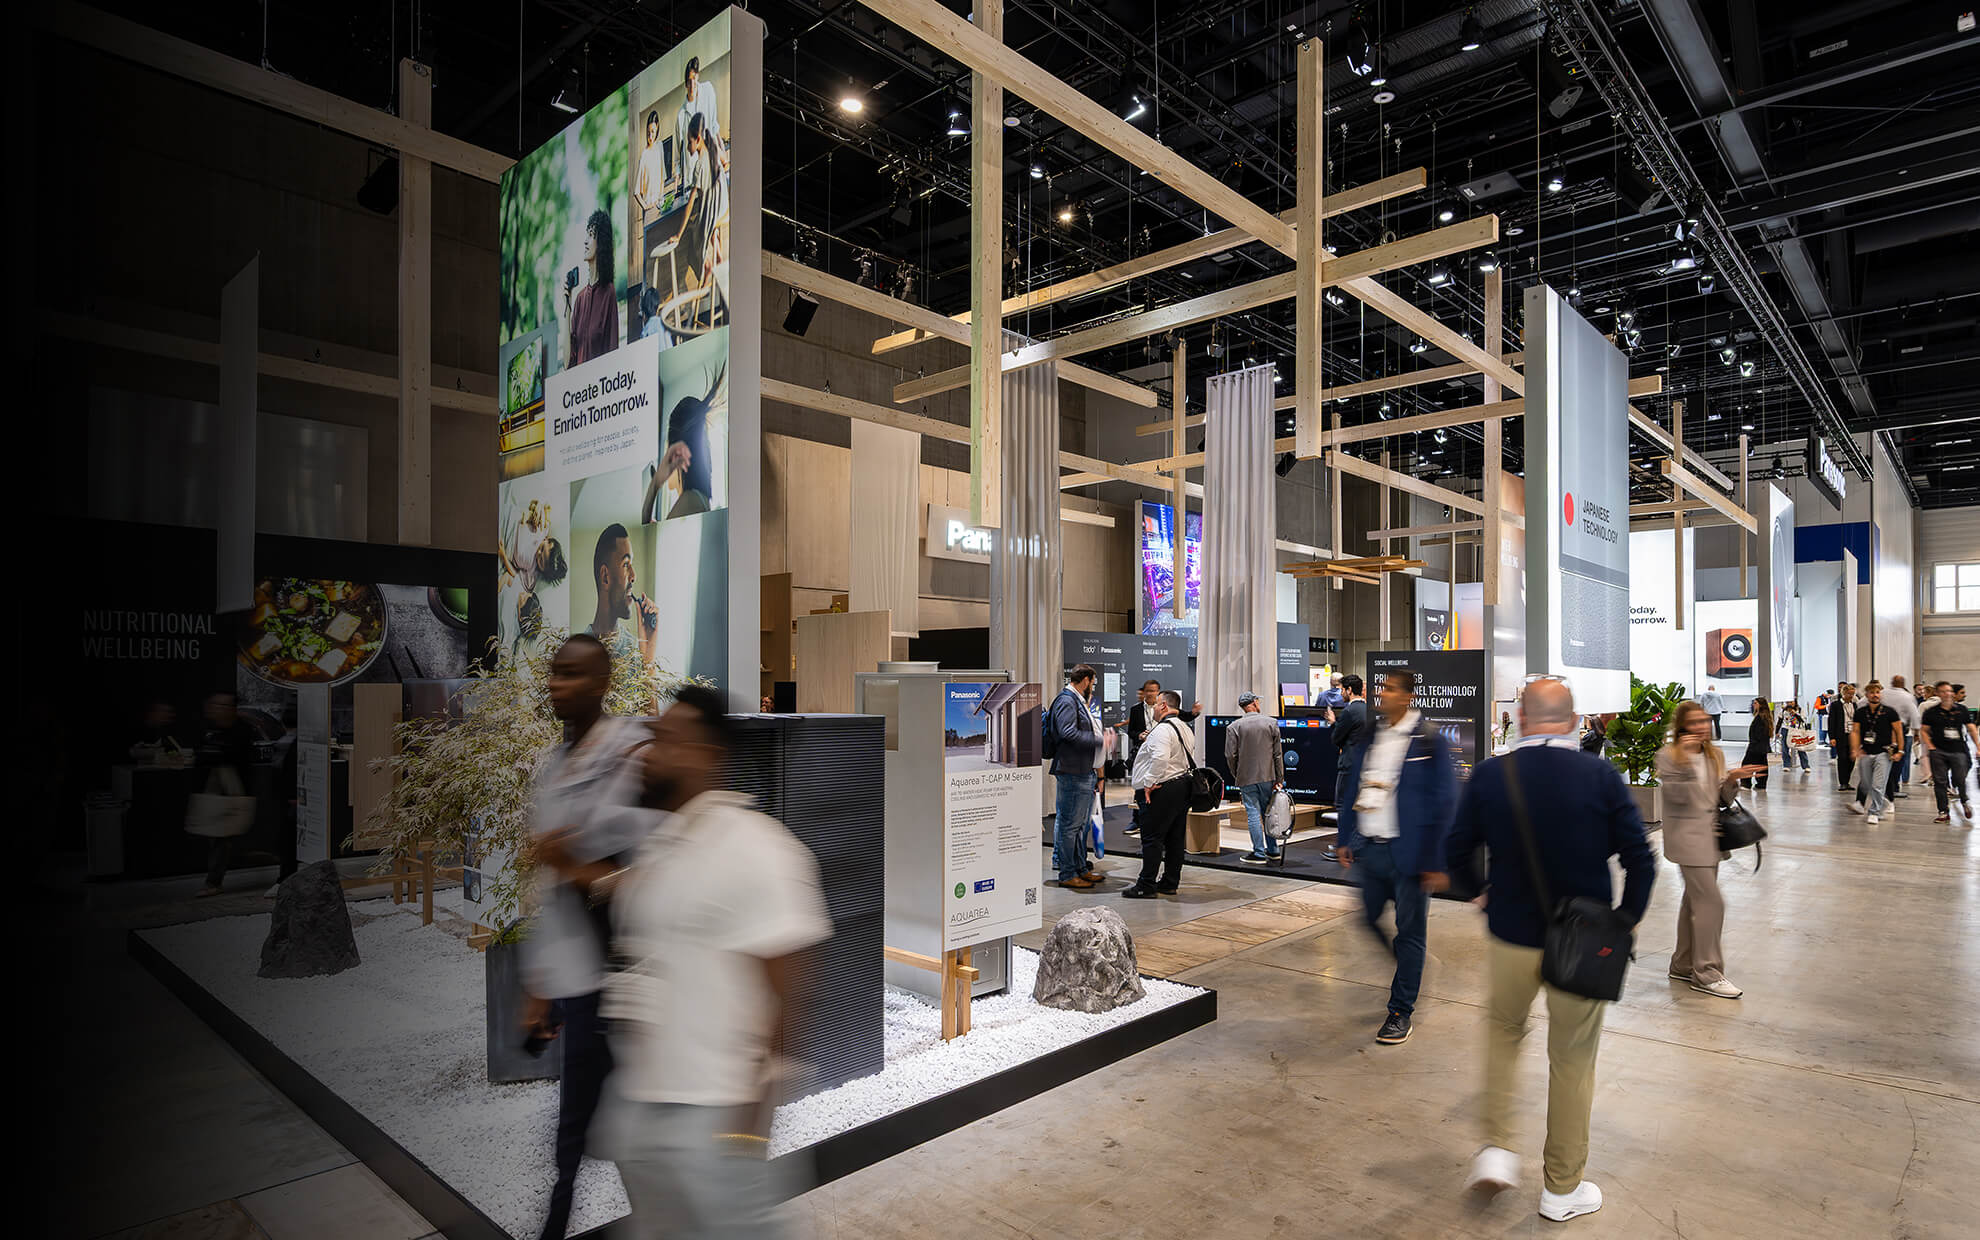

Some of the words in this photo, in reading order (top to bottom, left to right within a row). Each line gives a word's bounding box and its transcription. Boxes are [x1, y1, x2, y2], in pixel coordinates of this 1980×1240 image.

[562, 384, 598, 408] Create
[600, 370, 636, 395] Today.
[554, 410, 586, 436] Enrich
[588, 392, 648, 424] Tomorrow.
[1583, 500, 1610, 524] JAPANESE
[1583, 519, 1618, 544] TECHNOLOGY
[1629, 606, 1657, 616] oday.
[82, 609, 216, 634] NUTRITIONAL
[82, 636, 200, 660] WELLBEING
[1413, 674, 1423, 684] GB
[950, 690, 980, 699] Panasonic
[1429, 686, 1477, 696] TECHNOLOGY
[1409, 698, 1454, 708] RMALFLOW
[950, 776, 980, 788] Aquarea
[982, 772, 1002, 784] T-CAP
[1012, 772, 1032, 780] Series
[950, 907, 989, 923] AQUAREA
